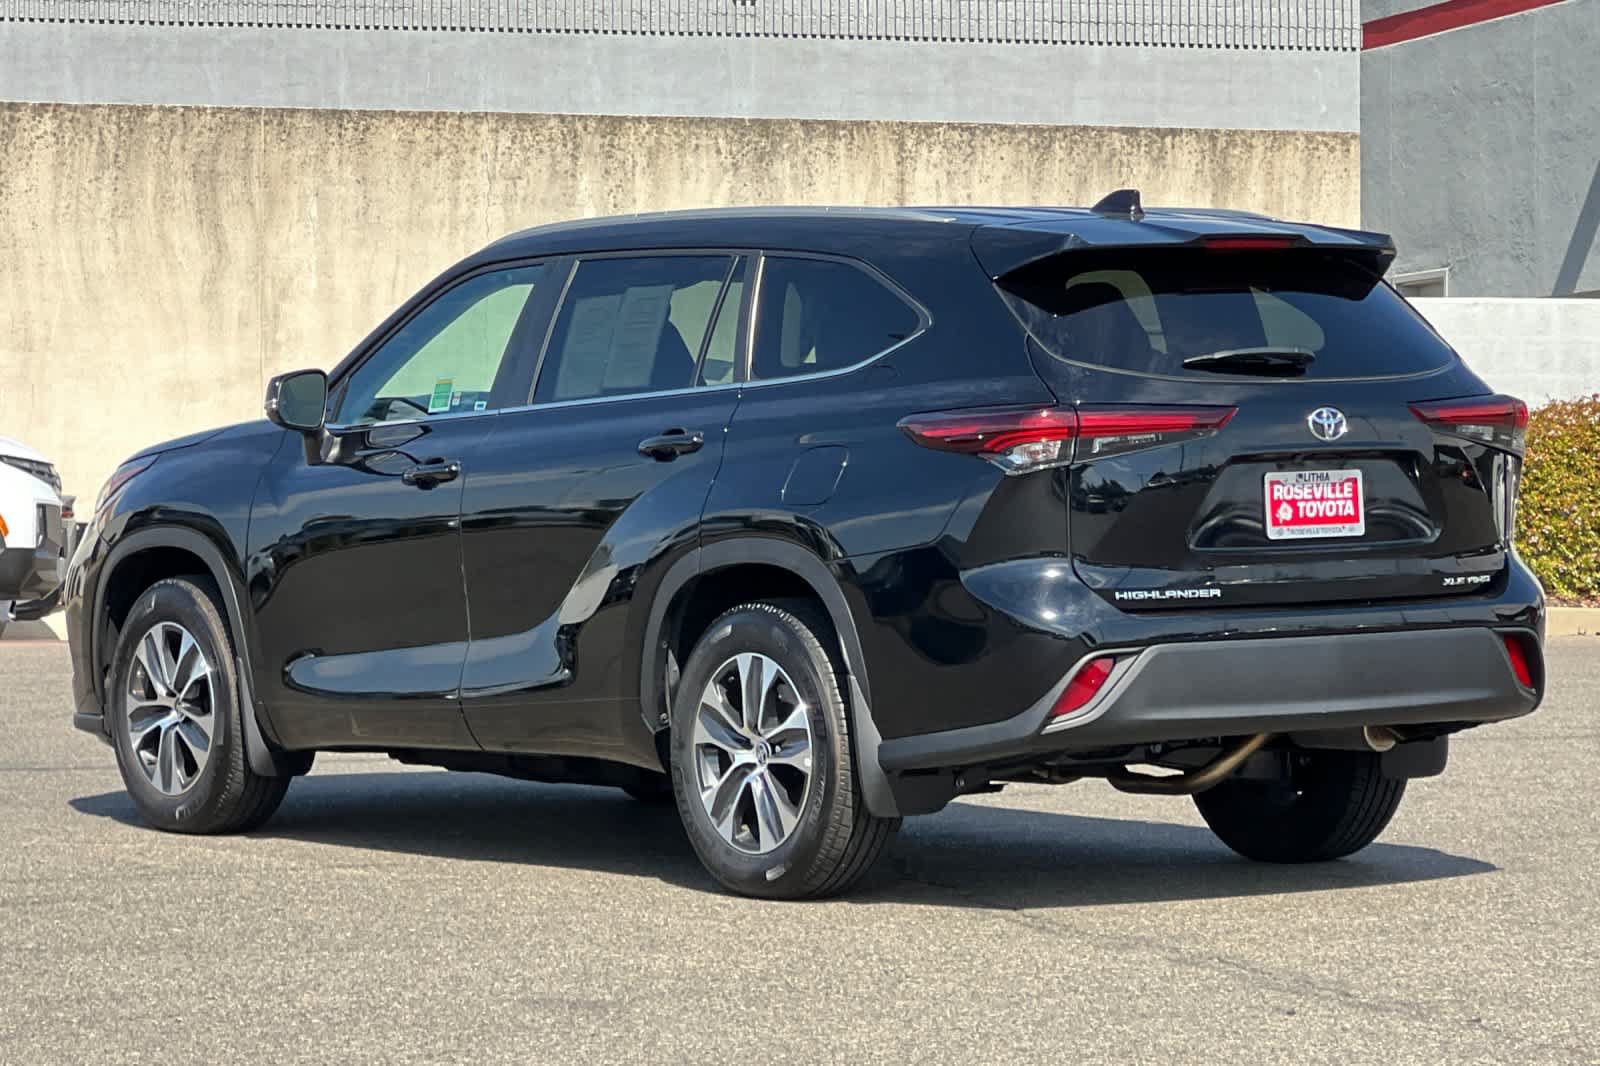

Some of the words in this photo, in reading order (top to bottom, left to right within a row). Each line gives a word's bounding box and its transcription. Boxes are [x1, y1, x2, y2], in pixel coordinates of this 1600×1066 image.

[1303, 472, 1330, 482] LITHIA
[1273, 482, 1353, 500] ROSEVILLE
[1297, 500, 1355, 518] TOYOTA
[1442, 577, 1466, 586] XLE
[1115, 588, 1221, 600] HIGHLANDER
